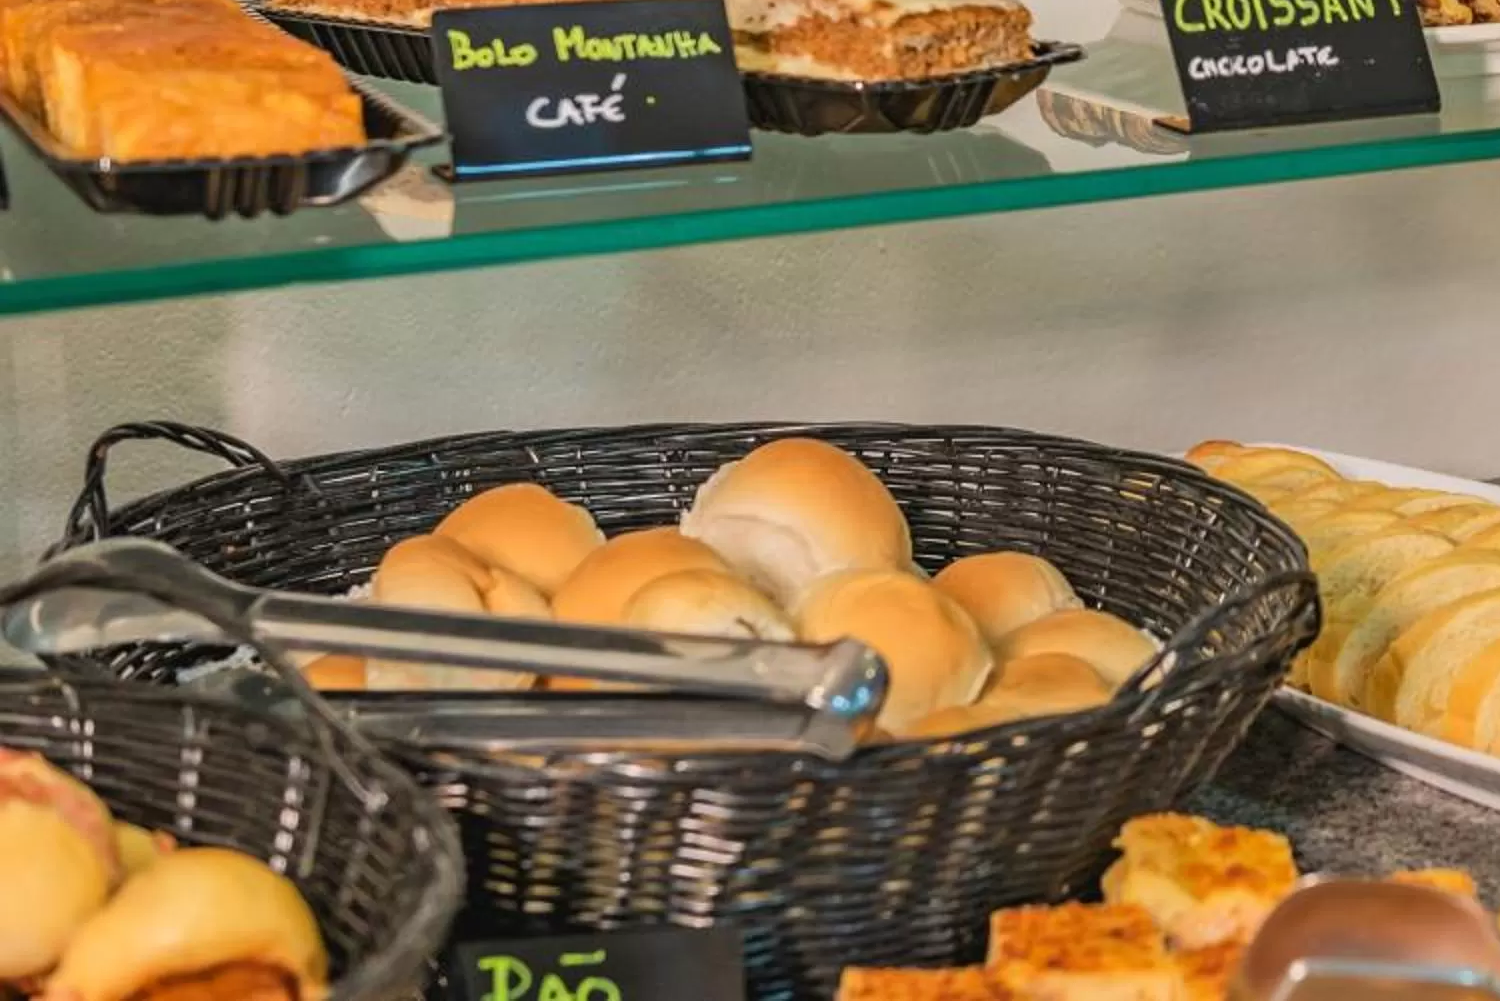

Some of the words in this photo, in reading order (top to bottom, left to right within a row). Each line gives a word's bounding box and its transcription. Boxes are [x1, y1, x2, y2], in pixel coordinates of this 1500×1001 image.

[447, 28, 539, 71] BOLO
[552, 24, 722, 63] MONTANHA
[524, 72, 628, 129] CAFÉ
